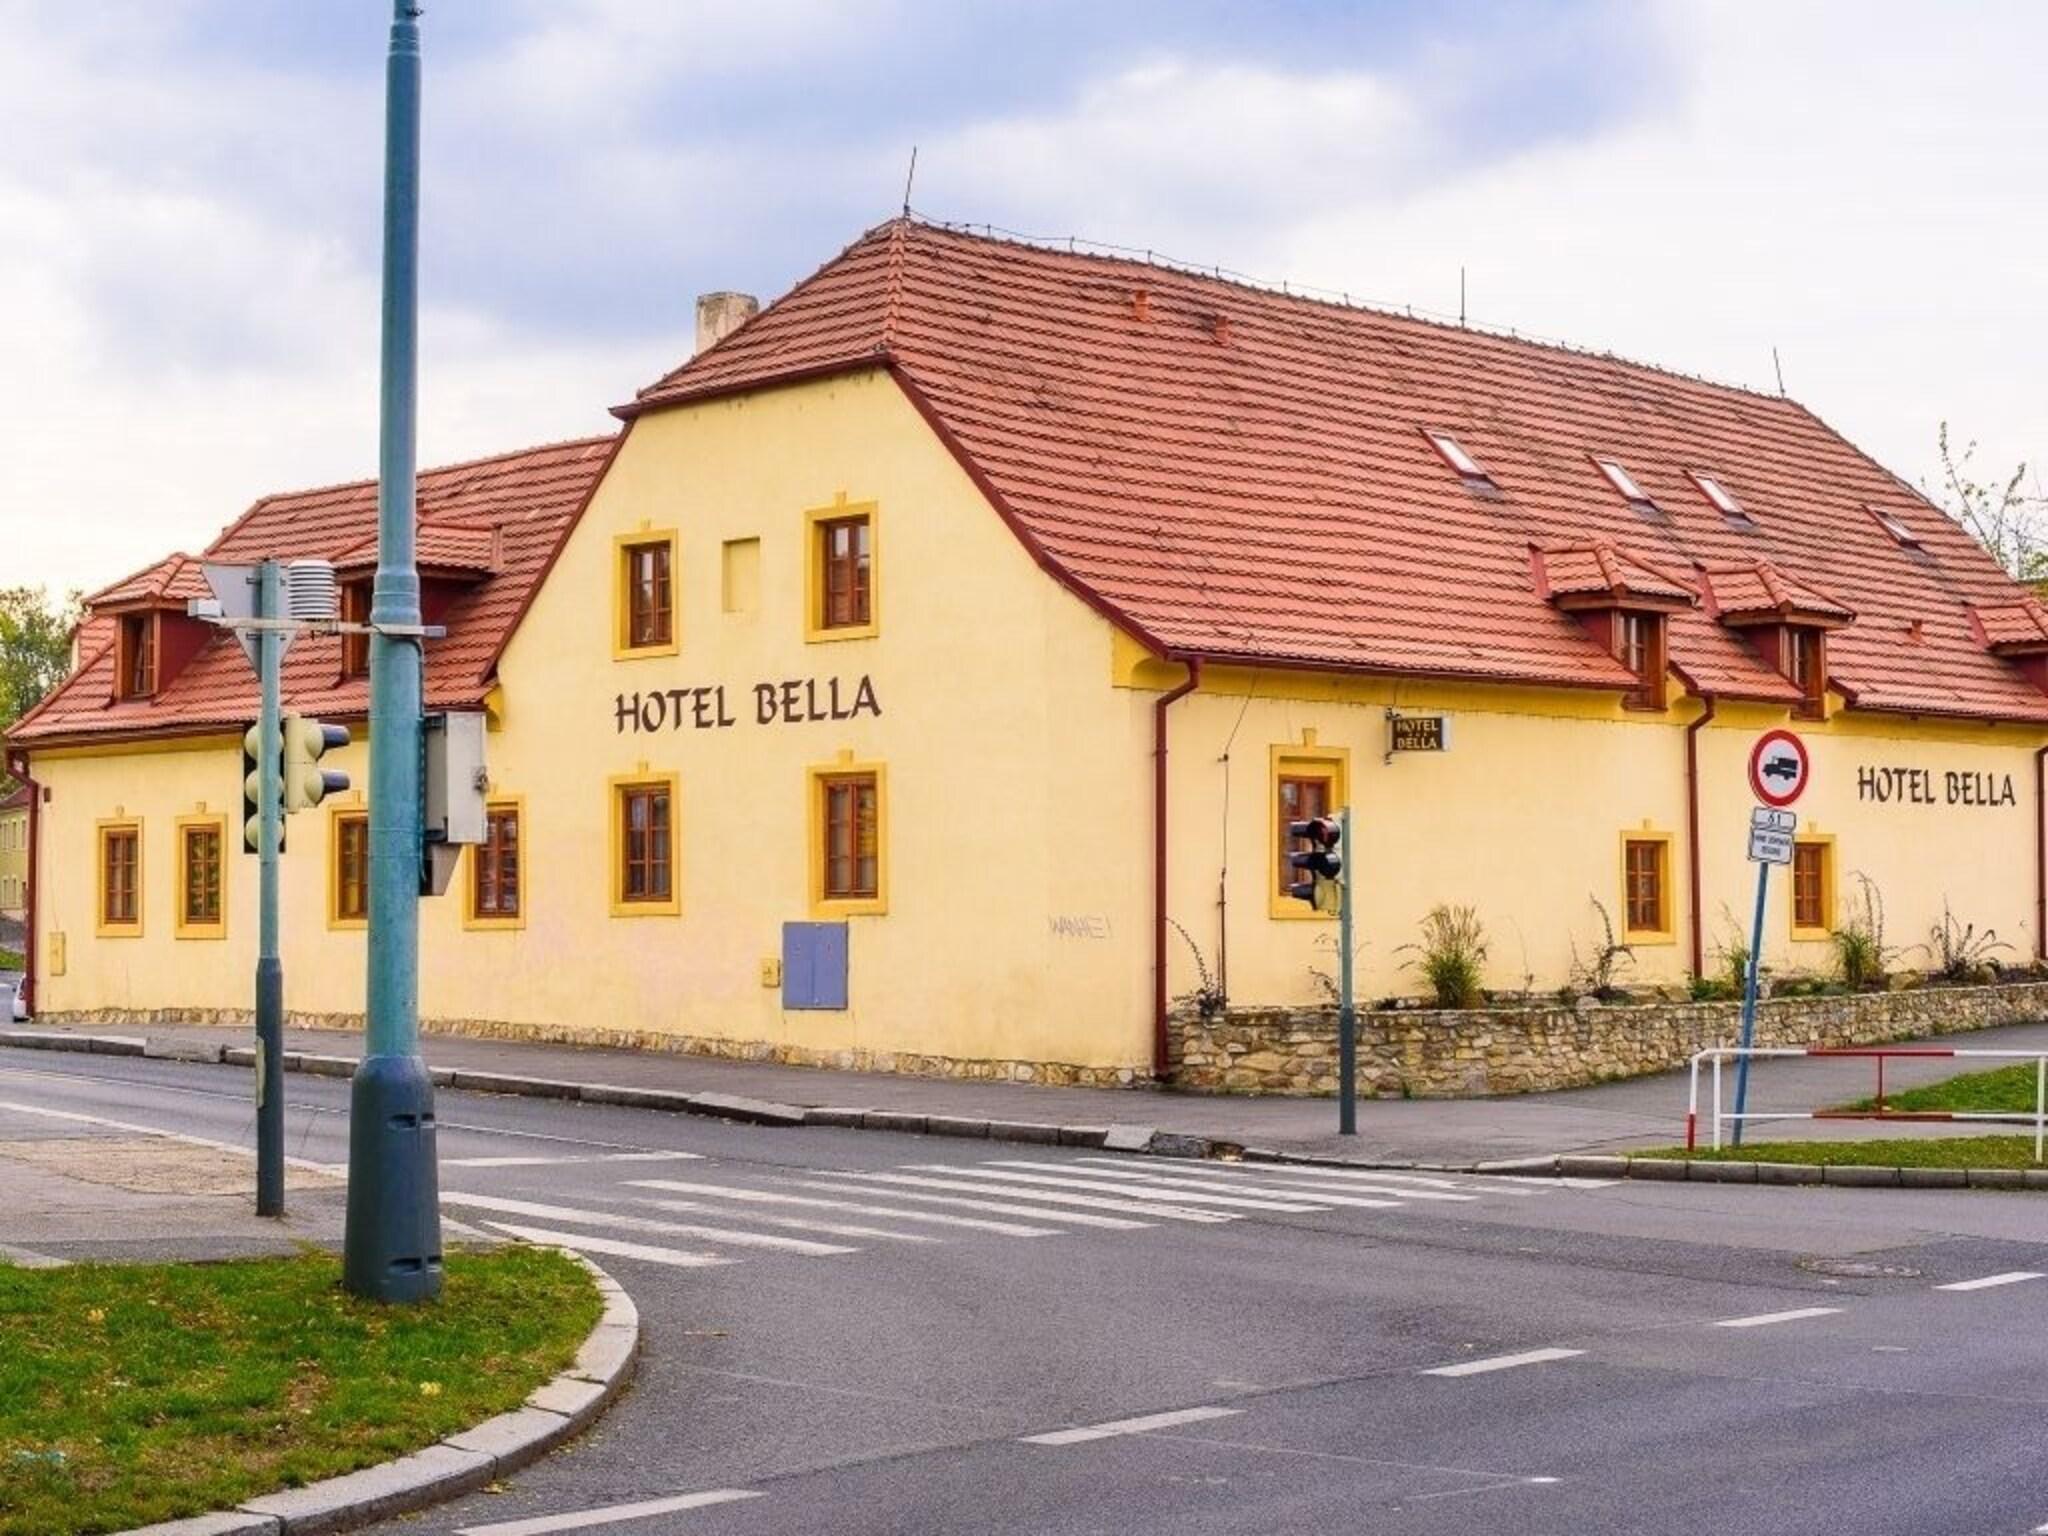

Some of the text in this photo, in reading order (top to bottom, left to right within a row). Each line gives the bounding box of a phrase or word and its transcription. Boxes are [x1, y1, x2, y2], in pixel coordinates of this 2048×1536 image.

[615, 674, 882, 734] HOTEL BELLA
[1396, 718, 1440, 733] HOTEL
[1396, 737, 1438, 749] BELLA
[1857, 765, 2016, 807] HOTEL BELLA
